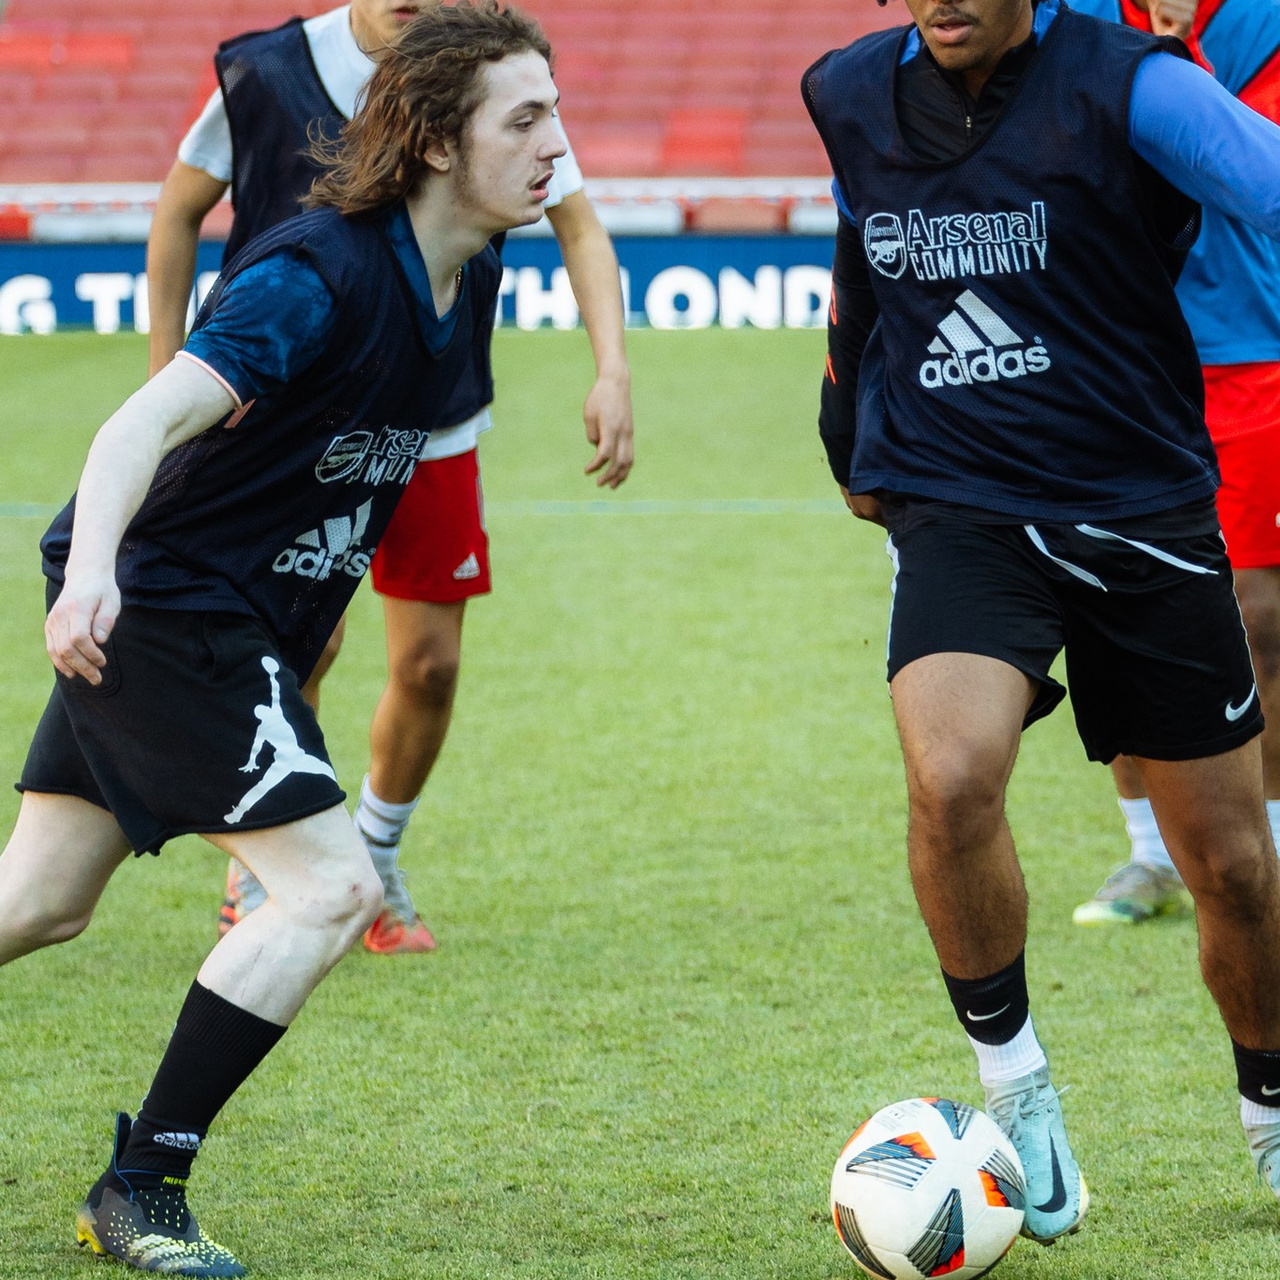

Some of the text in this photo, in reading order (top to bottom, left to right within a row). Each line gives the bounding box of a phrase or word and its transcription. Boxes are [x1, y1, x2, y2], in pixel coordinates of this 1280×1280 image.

[907, 201, 1048, 253] Arsenal
[909, 240, 1048, 281] COMMUNITY
[919, 345, 1051, 389] adidas
